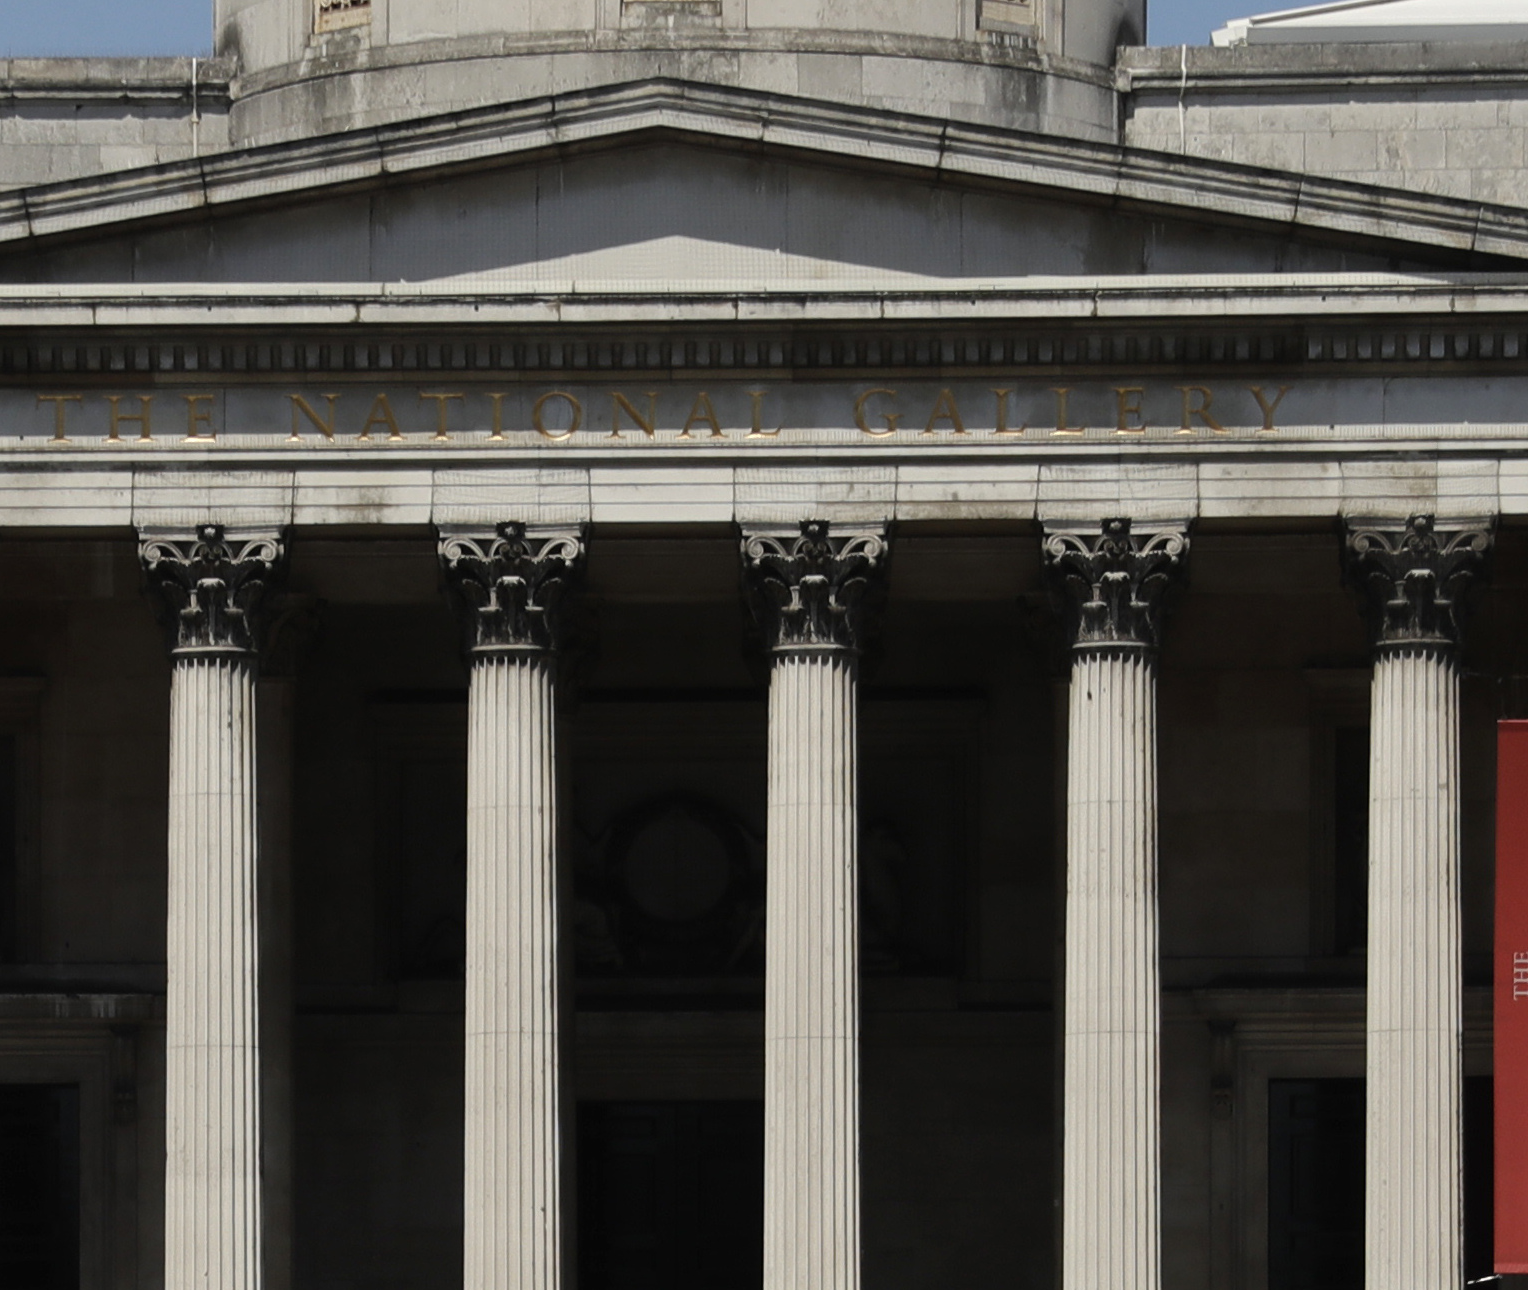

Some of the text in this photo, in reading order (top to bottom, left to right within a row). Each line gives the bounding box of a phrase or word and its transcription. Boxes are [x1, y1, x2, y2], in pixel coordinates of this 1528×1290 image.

[36, 384, 1295, 444] THE NATIONAL GALLERY
